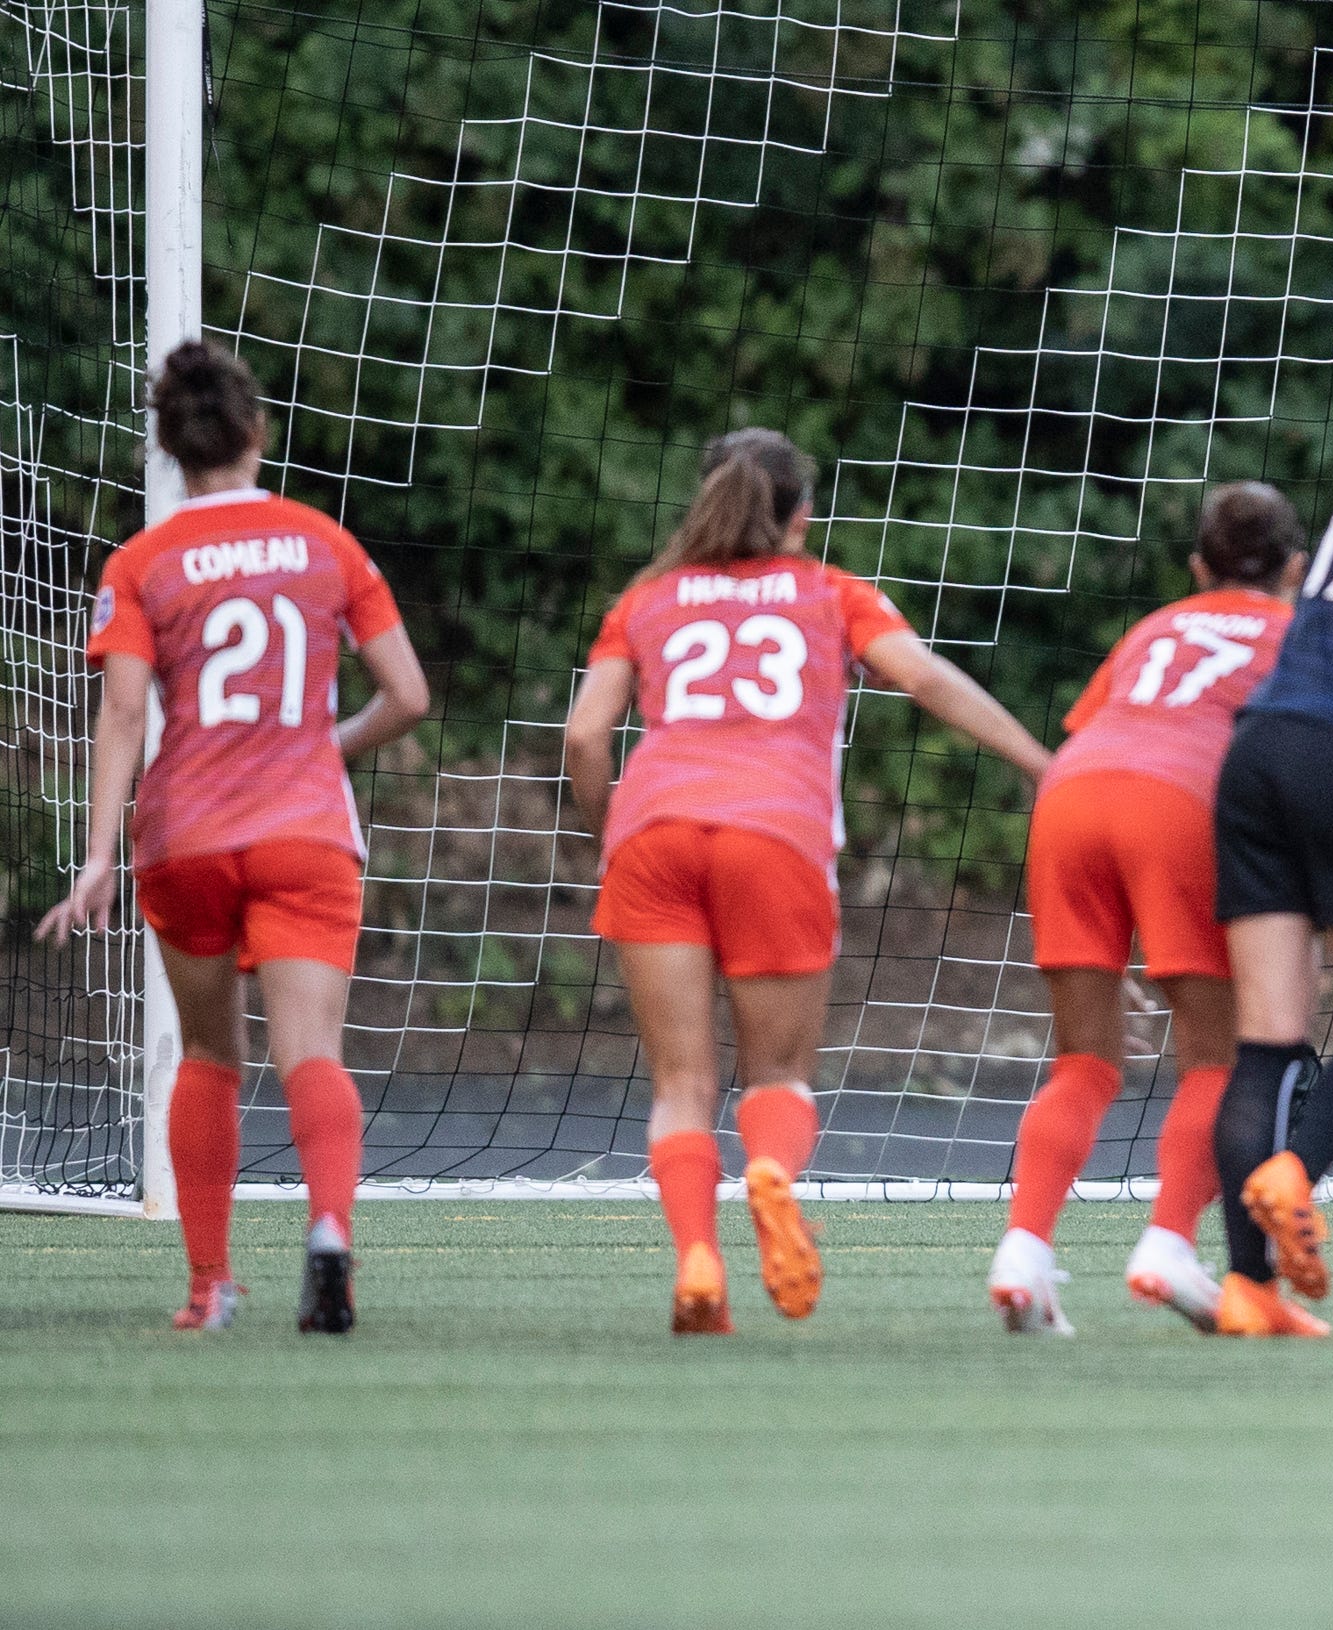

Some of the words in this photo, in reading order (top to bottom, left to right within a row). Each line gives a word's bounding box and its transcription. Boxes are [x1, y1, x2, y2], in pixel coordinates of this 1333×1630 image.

[182, 535, 309, 585] COMEAU
[198, 594, 308, 728] 21
[661, 613, 809, 724] 23
[1128, 629, 1255, 708] 17
